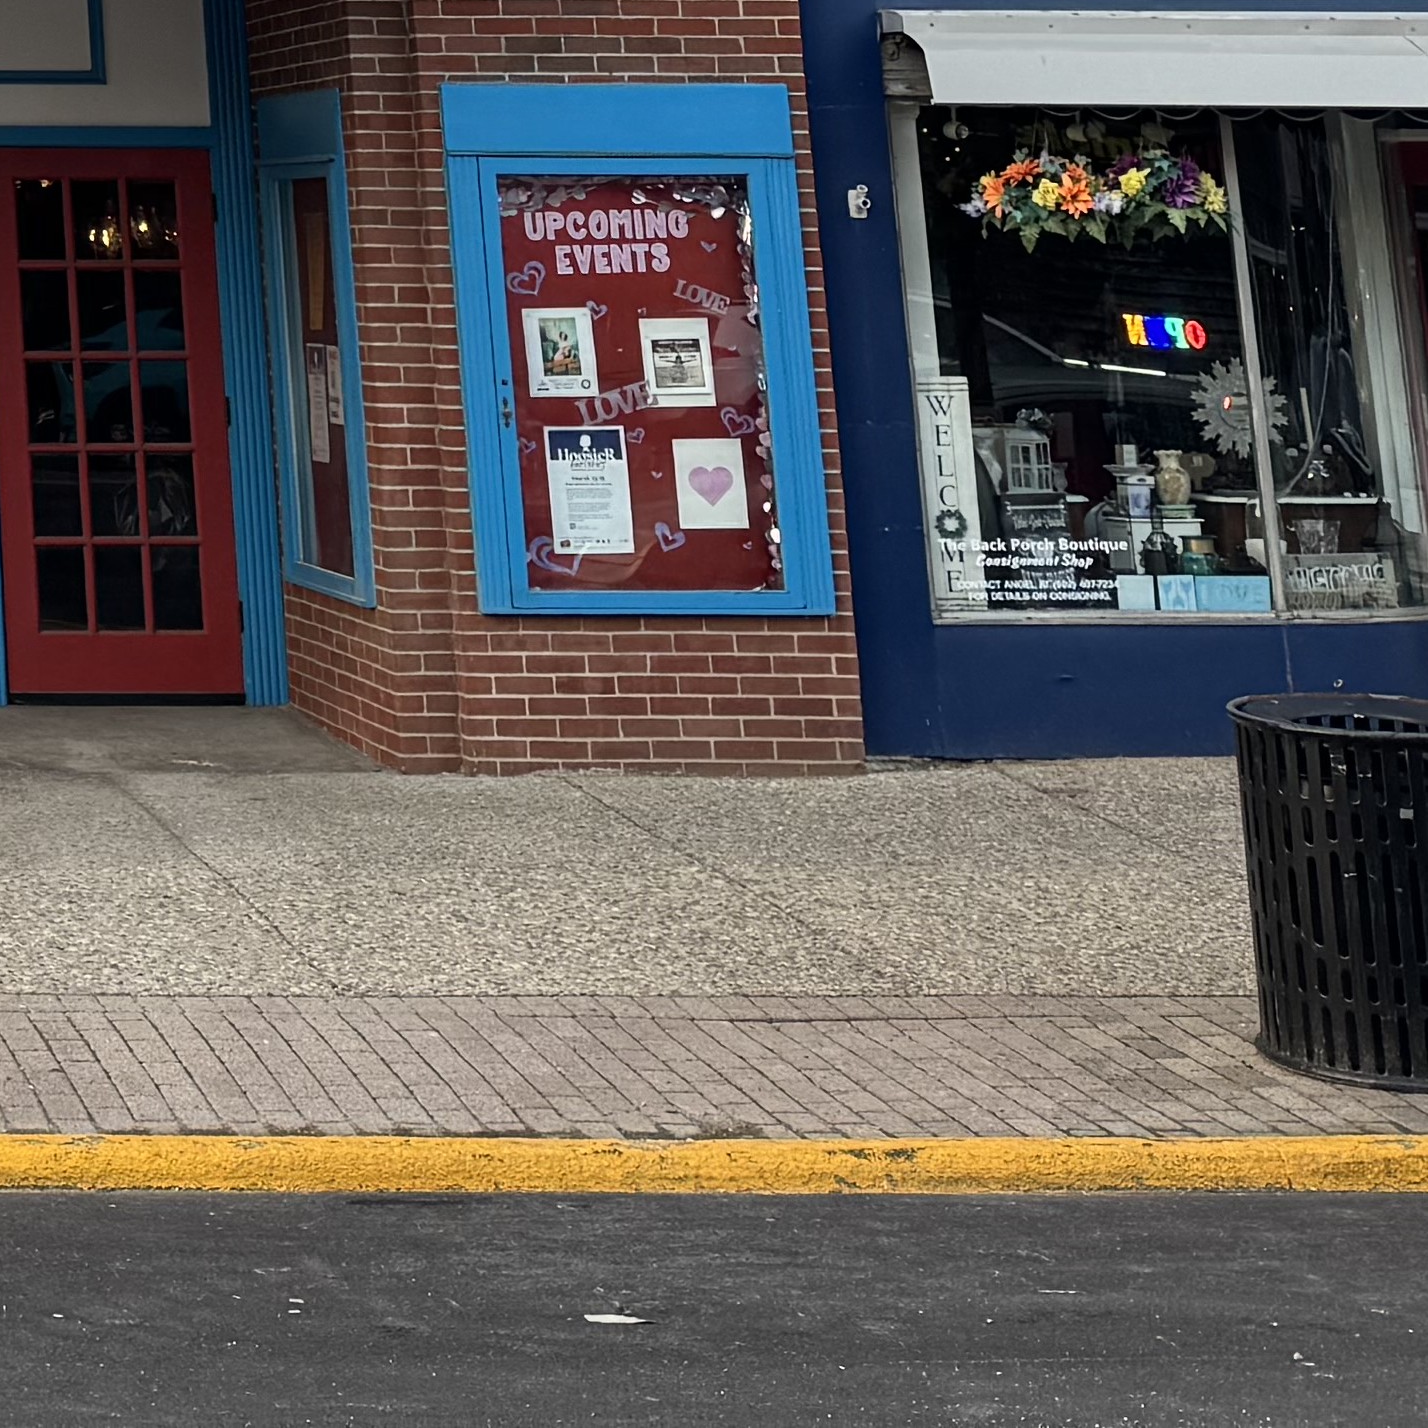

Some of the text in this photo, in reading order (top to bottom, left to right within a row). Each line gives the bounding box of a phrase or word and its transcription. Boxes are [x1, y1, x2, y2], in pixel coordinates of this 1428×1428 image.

[524, 209, 689, 241] UPCOMING
[555, 243, 670, 275] EVENTS
[673, 278, 730, 315] LOVE
[574, 379, 659, 427] LOVE
[938, 537, 1128, 554] The Back Porch Boutique
[976, 553, 1094, 569] Consignment Shop
[1032, 592, 1047, 600] ON
